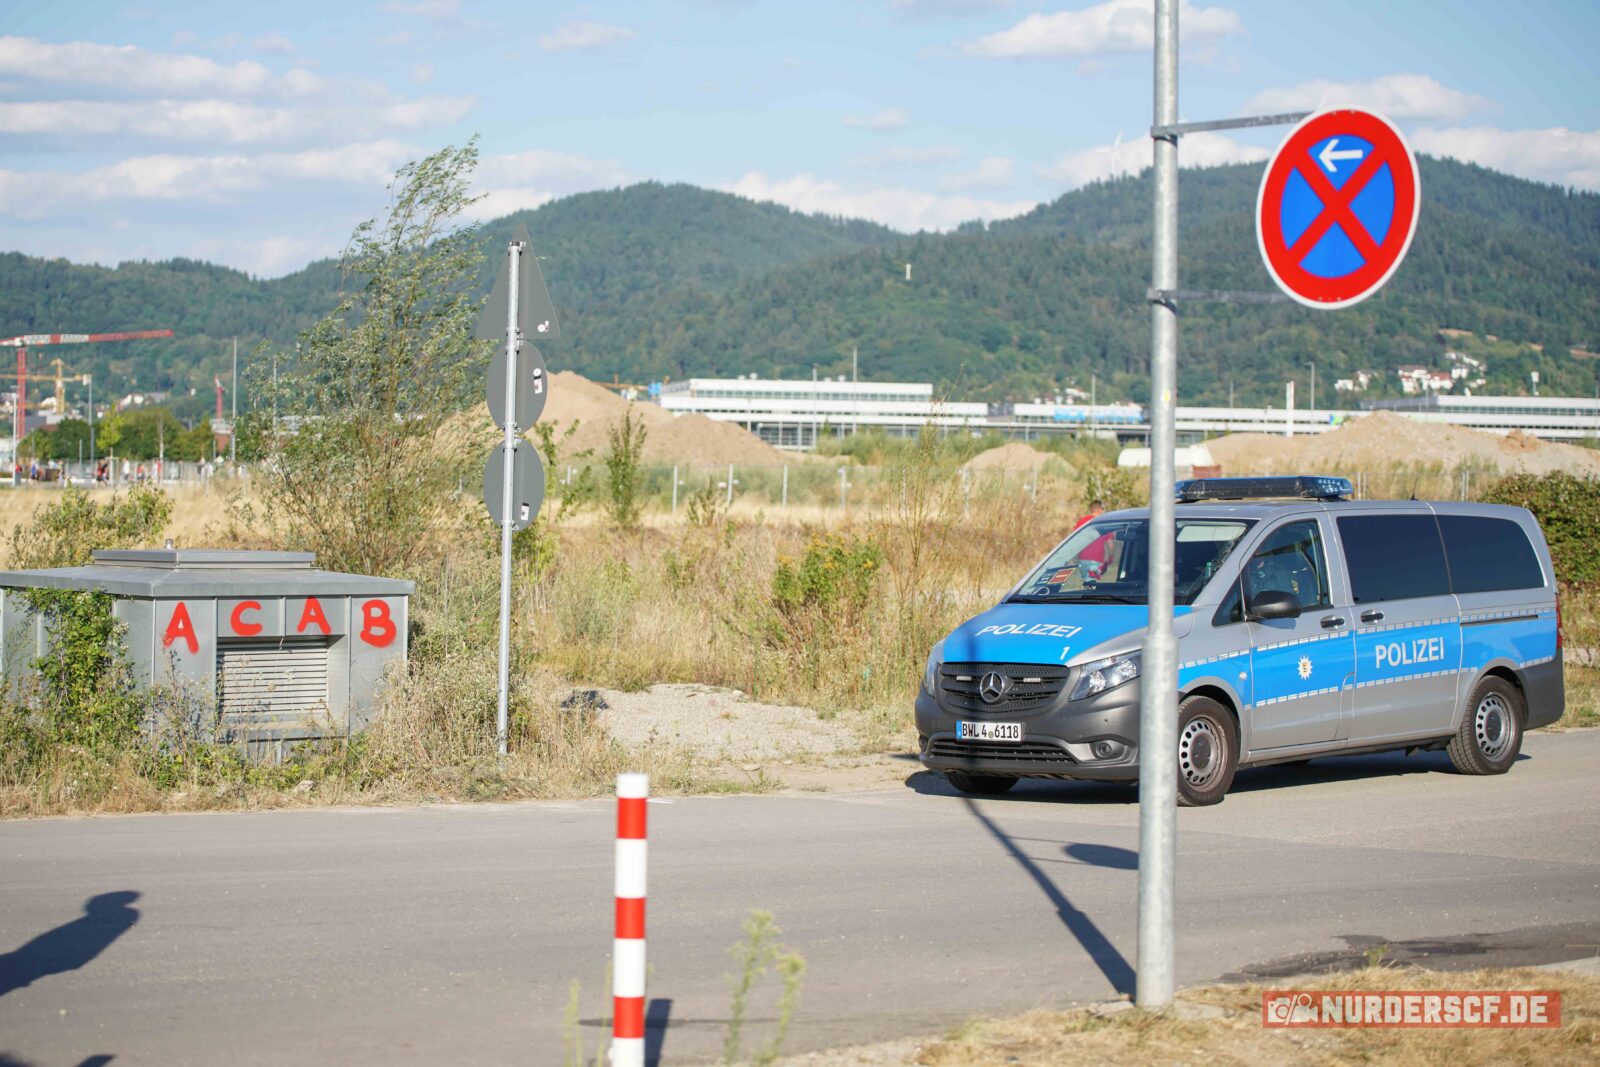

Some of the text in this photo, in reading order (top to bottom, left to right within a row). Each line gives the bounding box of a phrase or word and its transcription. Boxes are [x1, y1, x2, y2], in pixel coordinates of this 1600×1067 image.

[975, 624, 1082, 638] POLIZEI
[1060, 646, 1071, 660] 1
[1375, 637, 1444, 668] POLIZEI
[962, 722, 979, 737] BWL
[994, 725, 1019, 739] 6118
